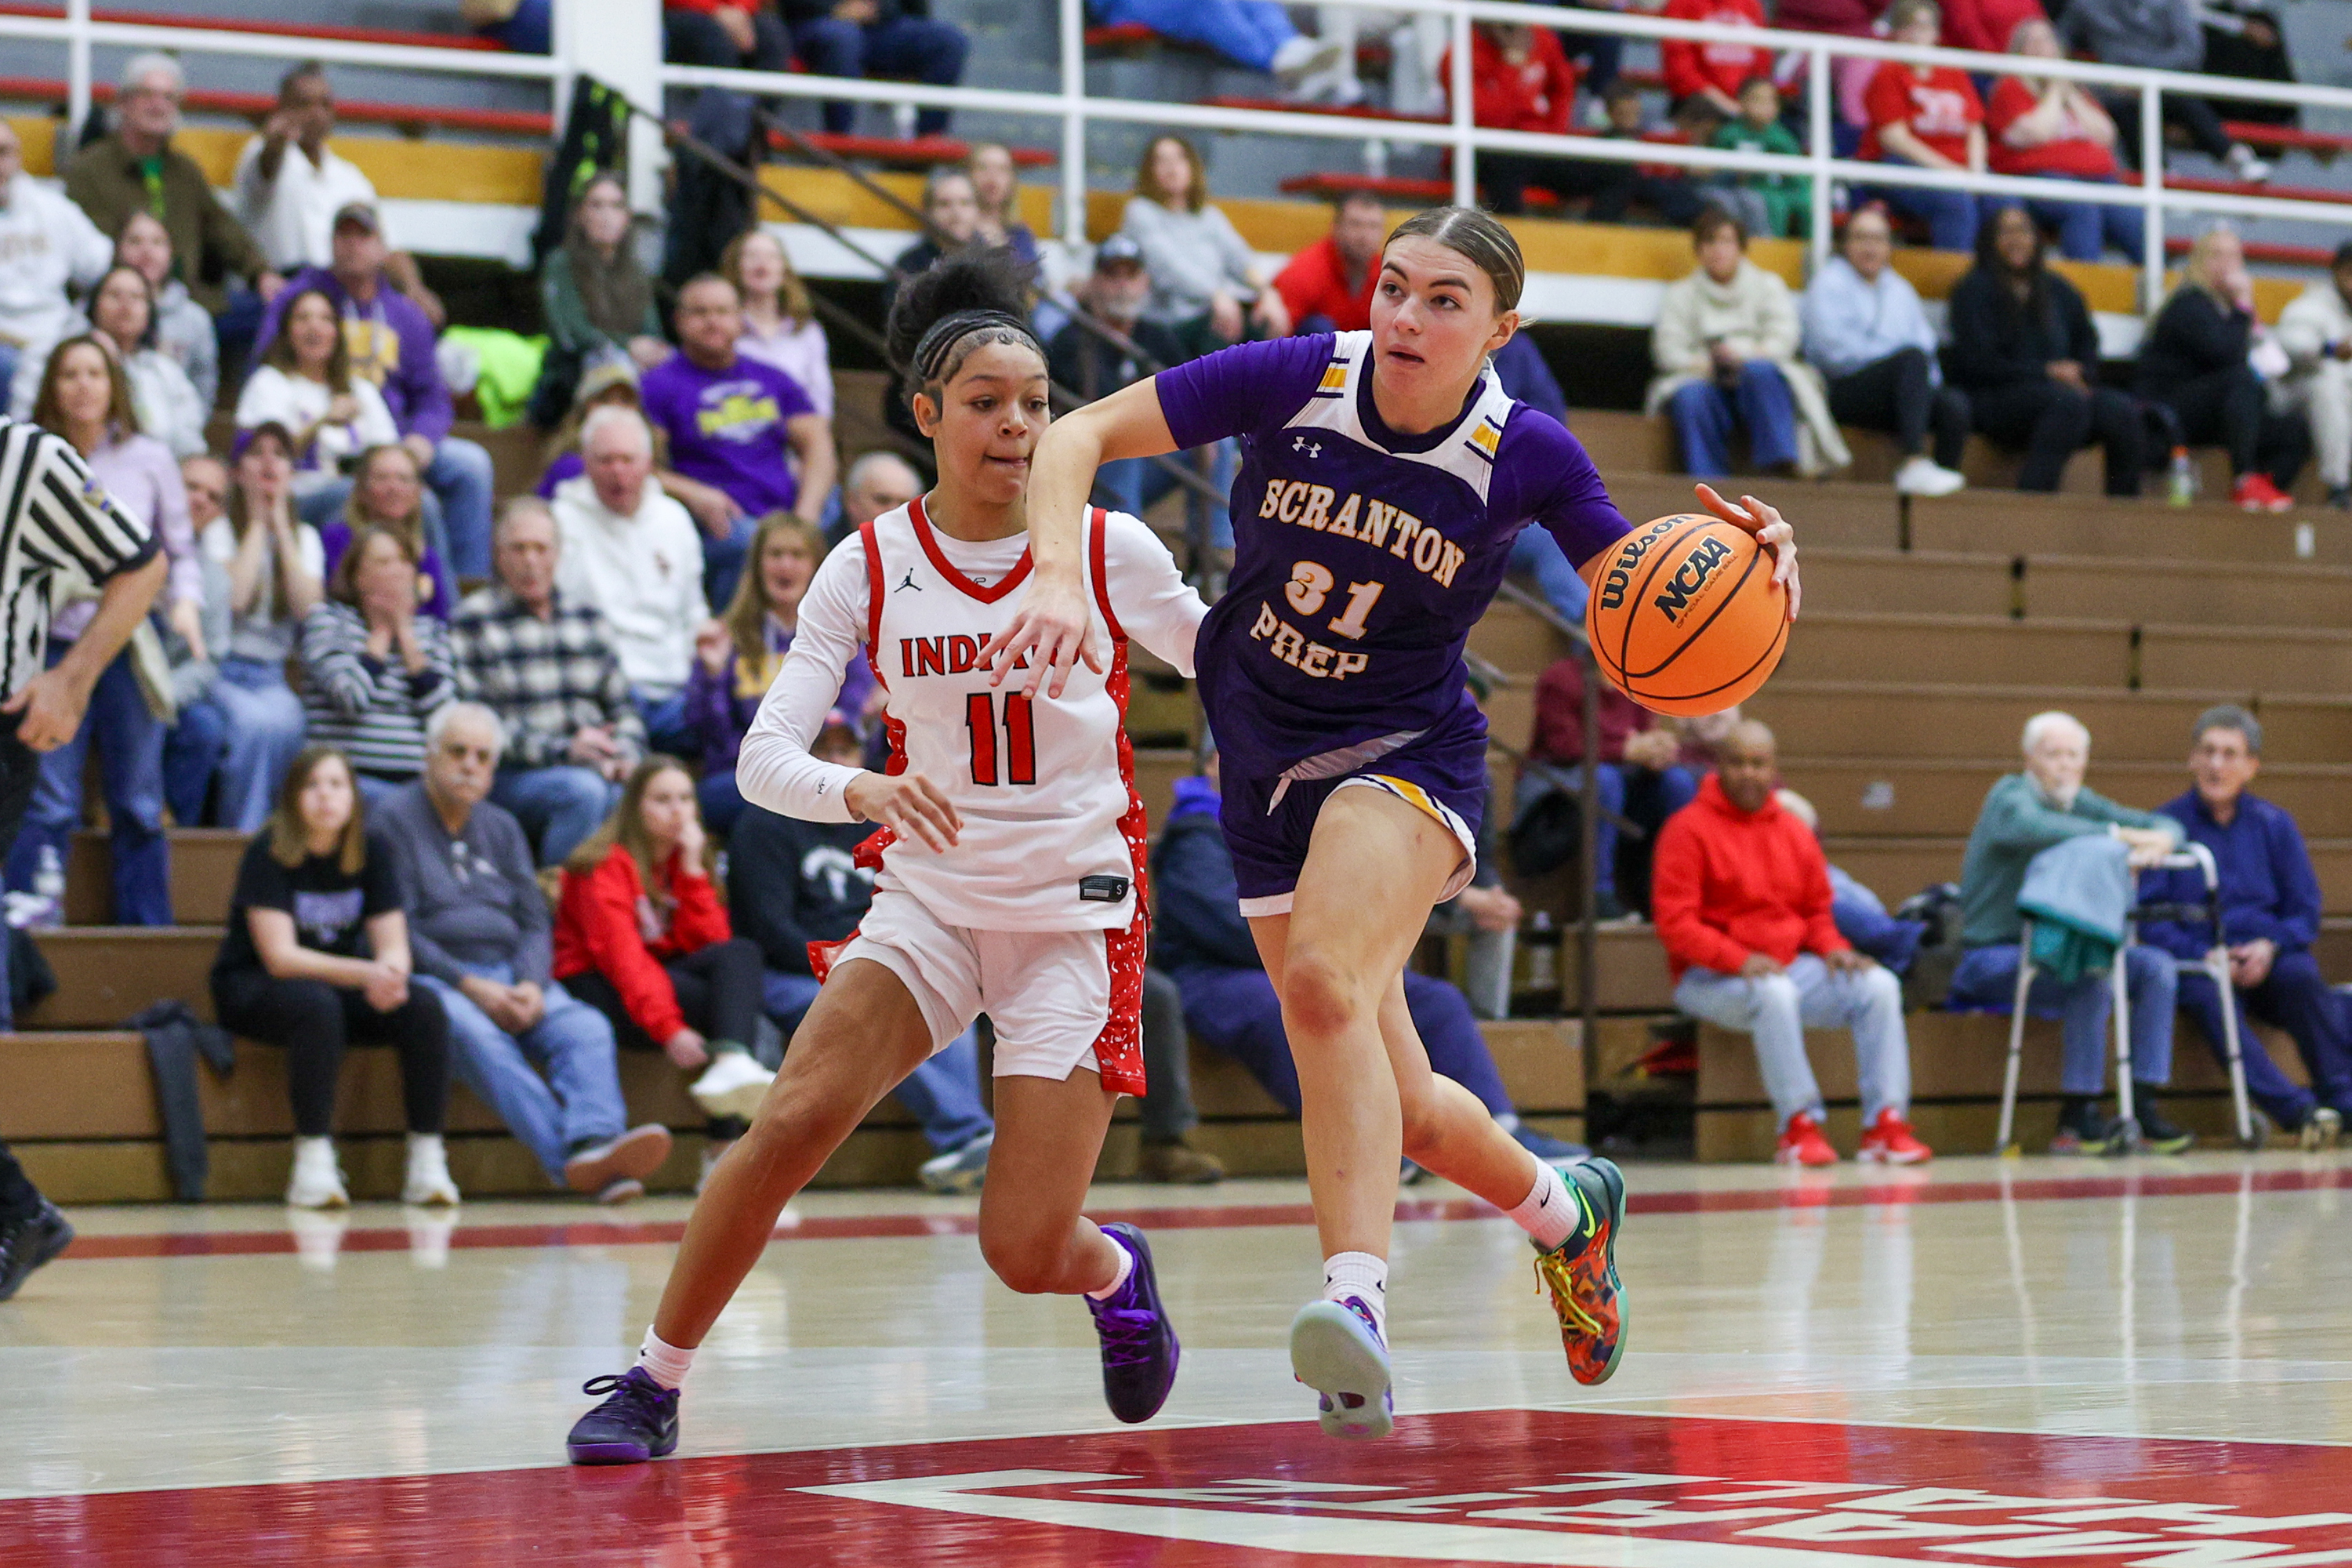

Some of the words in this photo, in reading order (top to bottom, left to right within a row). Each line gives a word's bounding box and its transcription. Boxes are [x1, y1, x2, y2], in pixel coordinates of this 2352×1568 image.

[1258, 478, 1466, 589] SCRANTON
[1600, 515, 1696, 611] Wilson
[1283, 560, 1385, 641] 31
[1653, 535, 1734, 623] NCAA
[1676, 593, 1705, 629] OFFICIAL
[1704, 569, 1724, 592] GAME
[1722, 554, 1739, 571] BALL
[1249, 600, 1369, 681] PREP
[965, 691, 1036, 786] 11
[1116, 884, 1123, 895] S
